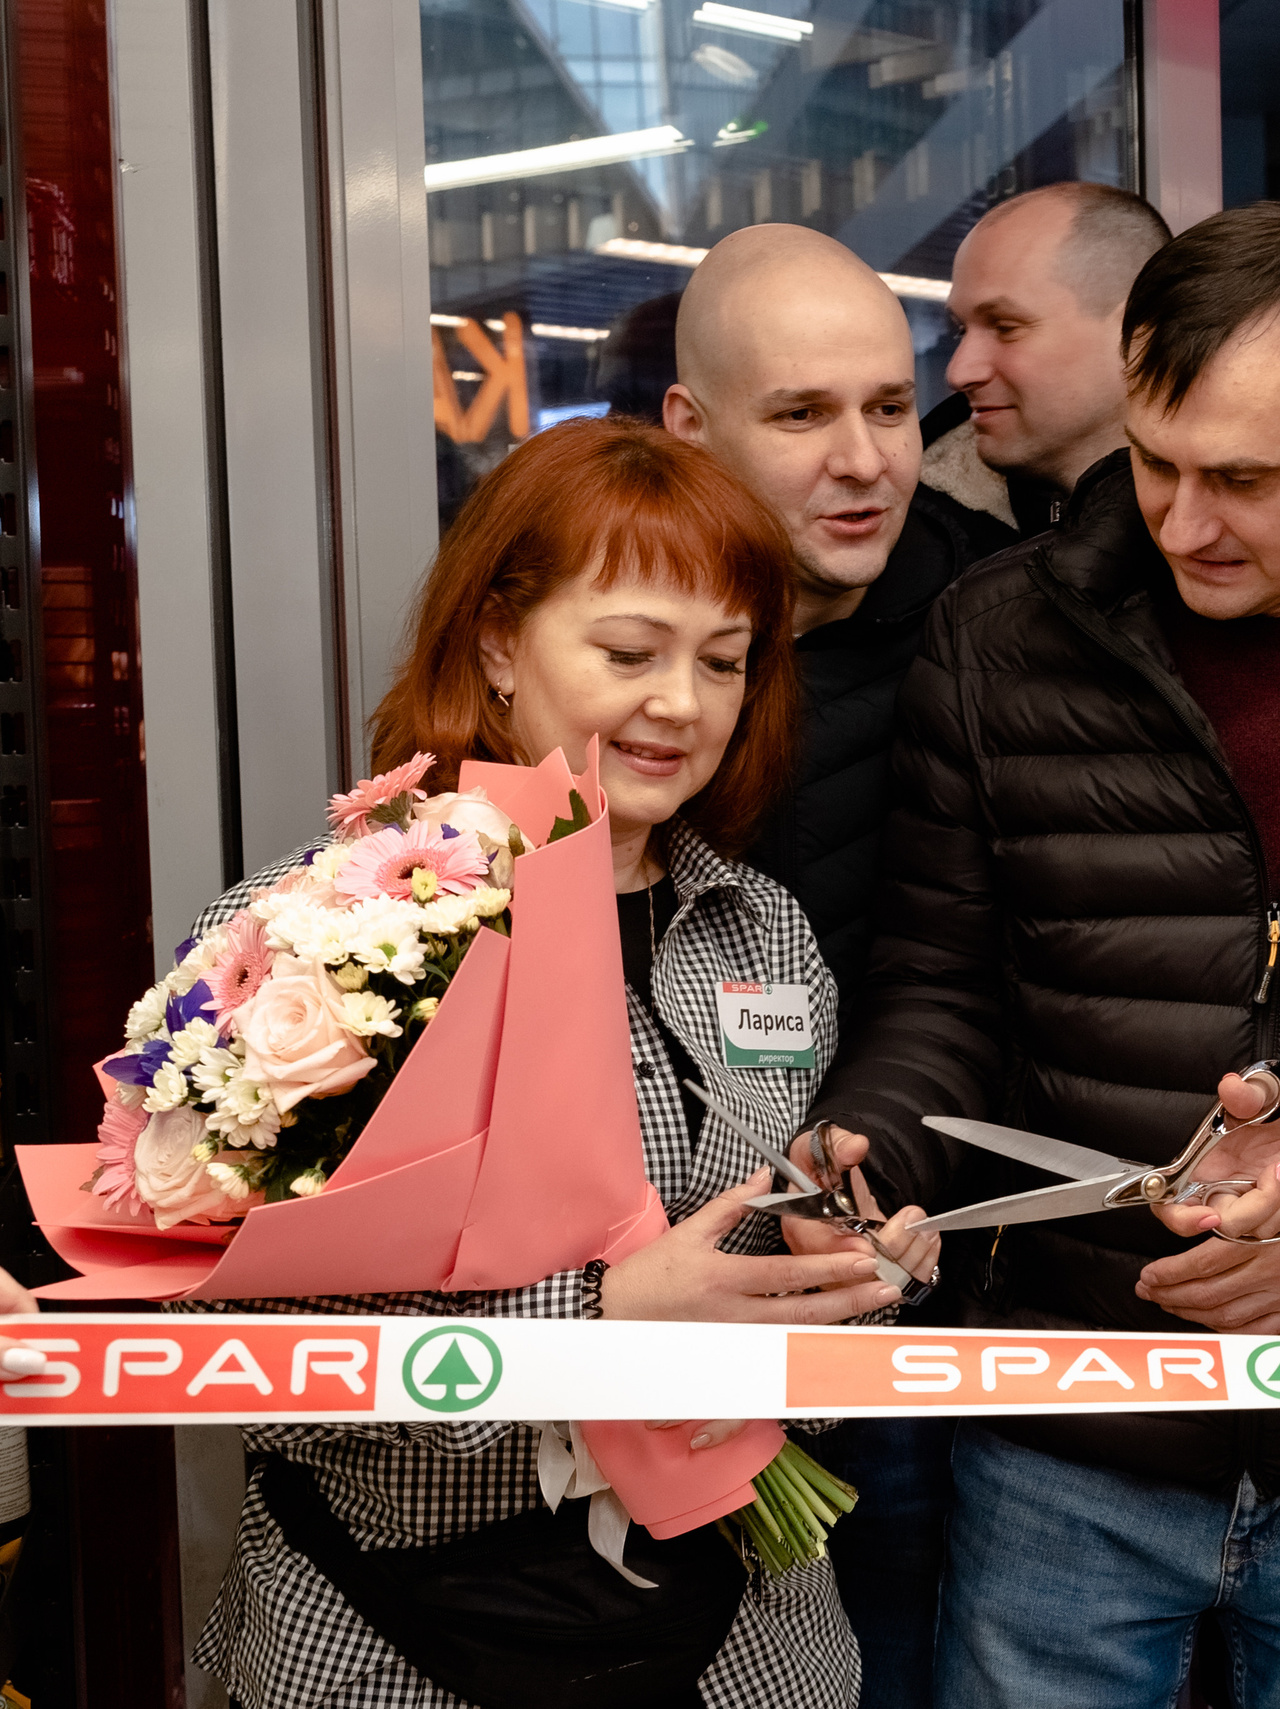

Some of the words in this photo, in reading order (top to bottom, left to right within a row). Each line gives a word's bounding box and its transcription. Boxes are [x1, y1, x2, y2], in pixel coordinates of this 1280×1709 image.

[731, 984, 763, 993] SPAR
[738, 1008, 804, 1036] Лариса
[758, 1054, 795, 1065] директор
[3, 1338, 369, 1398] SPAR
[891, 1345, 1219, 1393] SPAR
